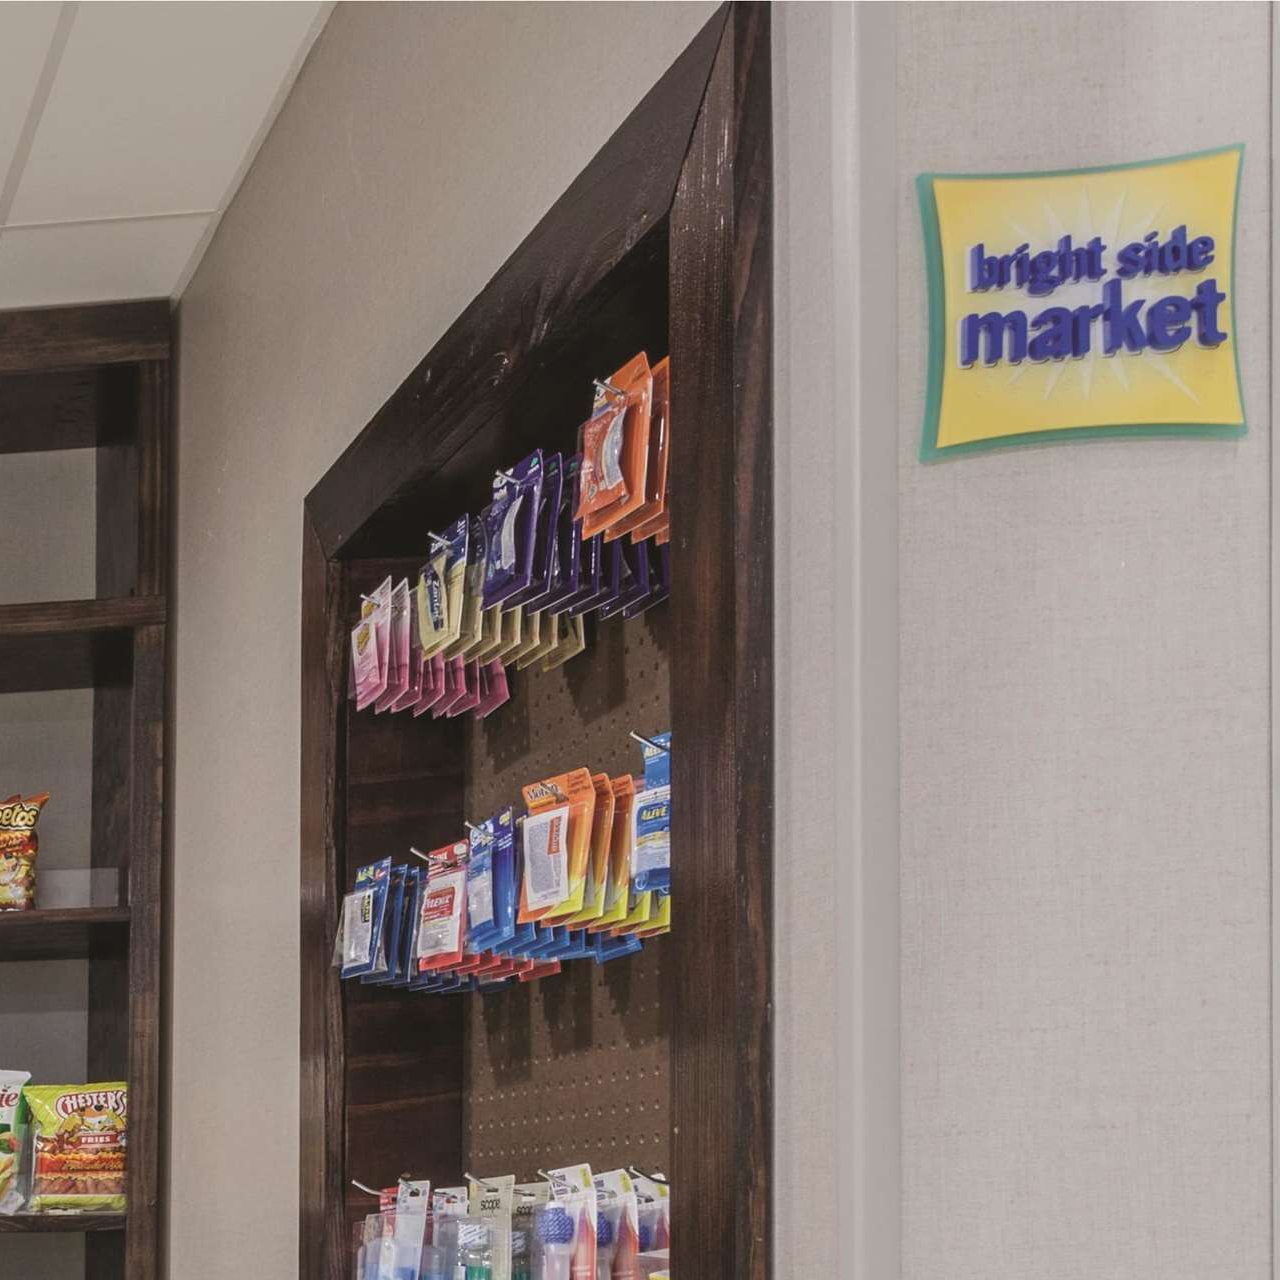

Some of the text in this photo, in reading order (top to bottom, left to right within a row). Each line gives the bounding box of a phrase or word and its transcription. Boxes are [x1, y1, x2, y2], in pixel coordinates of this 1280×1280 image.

[970, 225, 1215, 297] bright side
[960, 278, 1227, 367] market
[82, 1136, 111, 1144] FRIES
